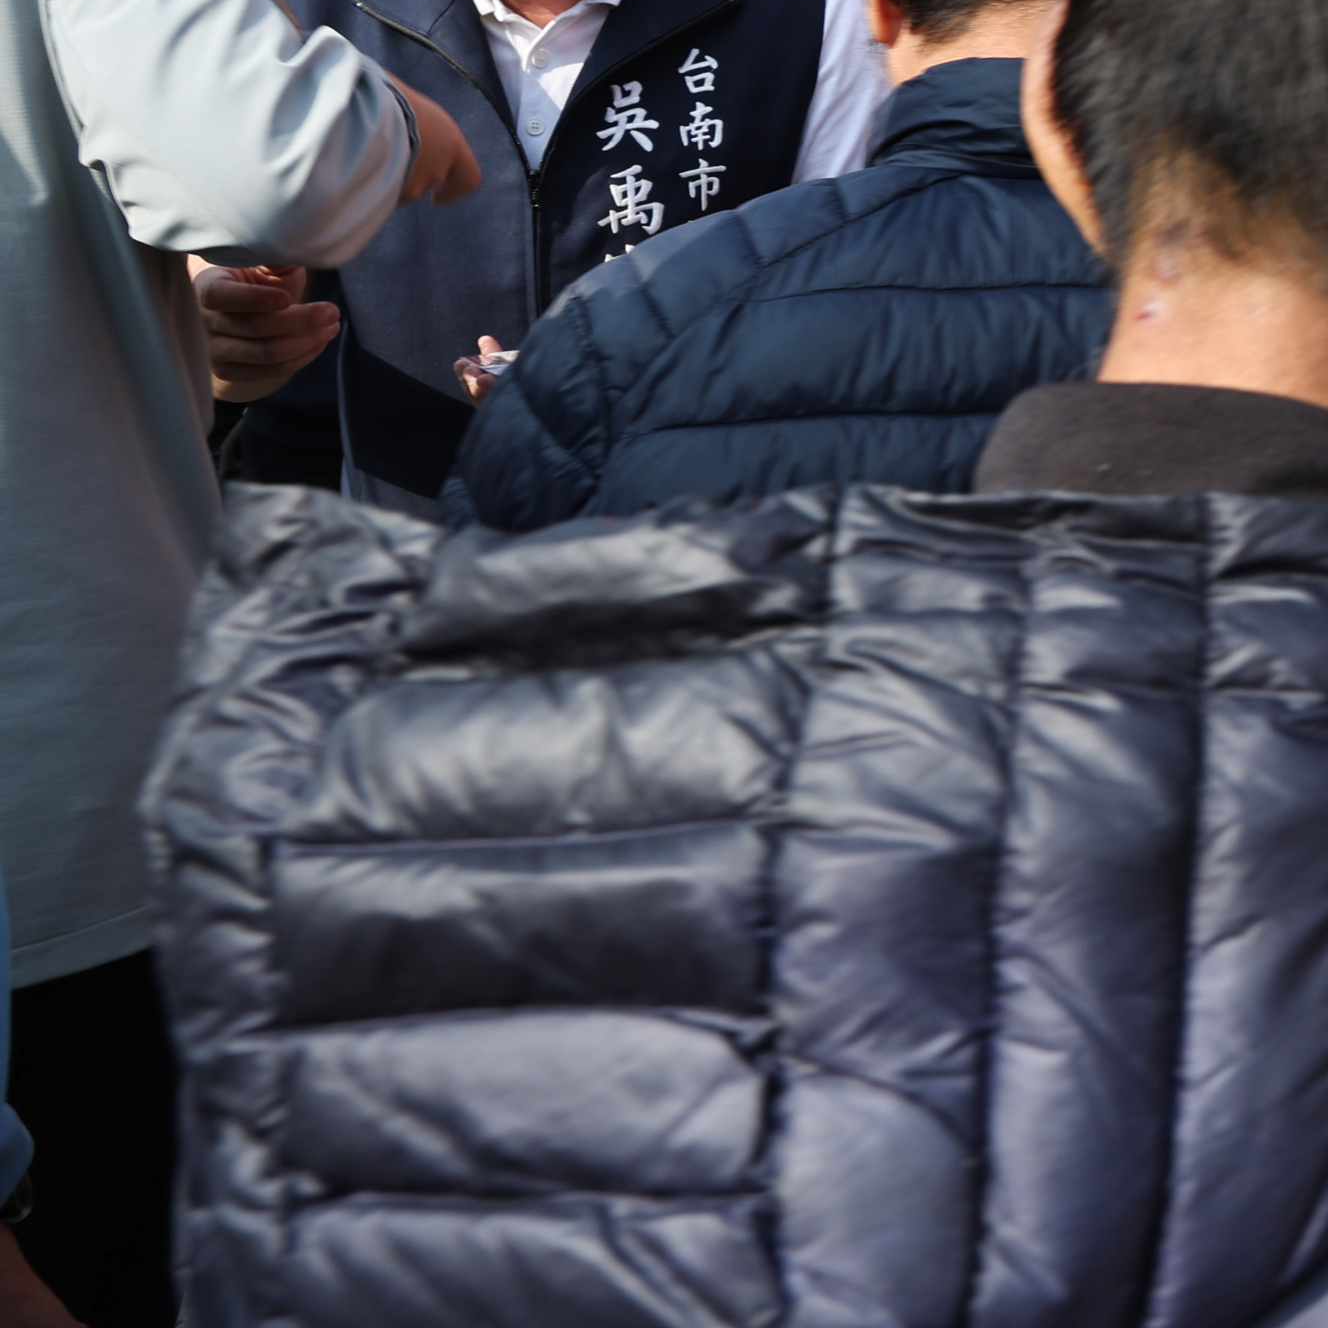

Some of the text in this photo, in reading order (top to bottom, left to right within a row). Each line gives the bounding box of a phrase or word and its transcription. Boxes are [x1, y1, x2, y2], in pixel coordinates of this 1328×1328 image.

[596, 80, 665, 263] 吳禹
[677, 48, 727, 212] 台南市
